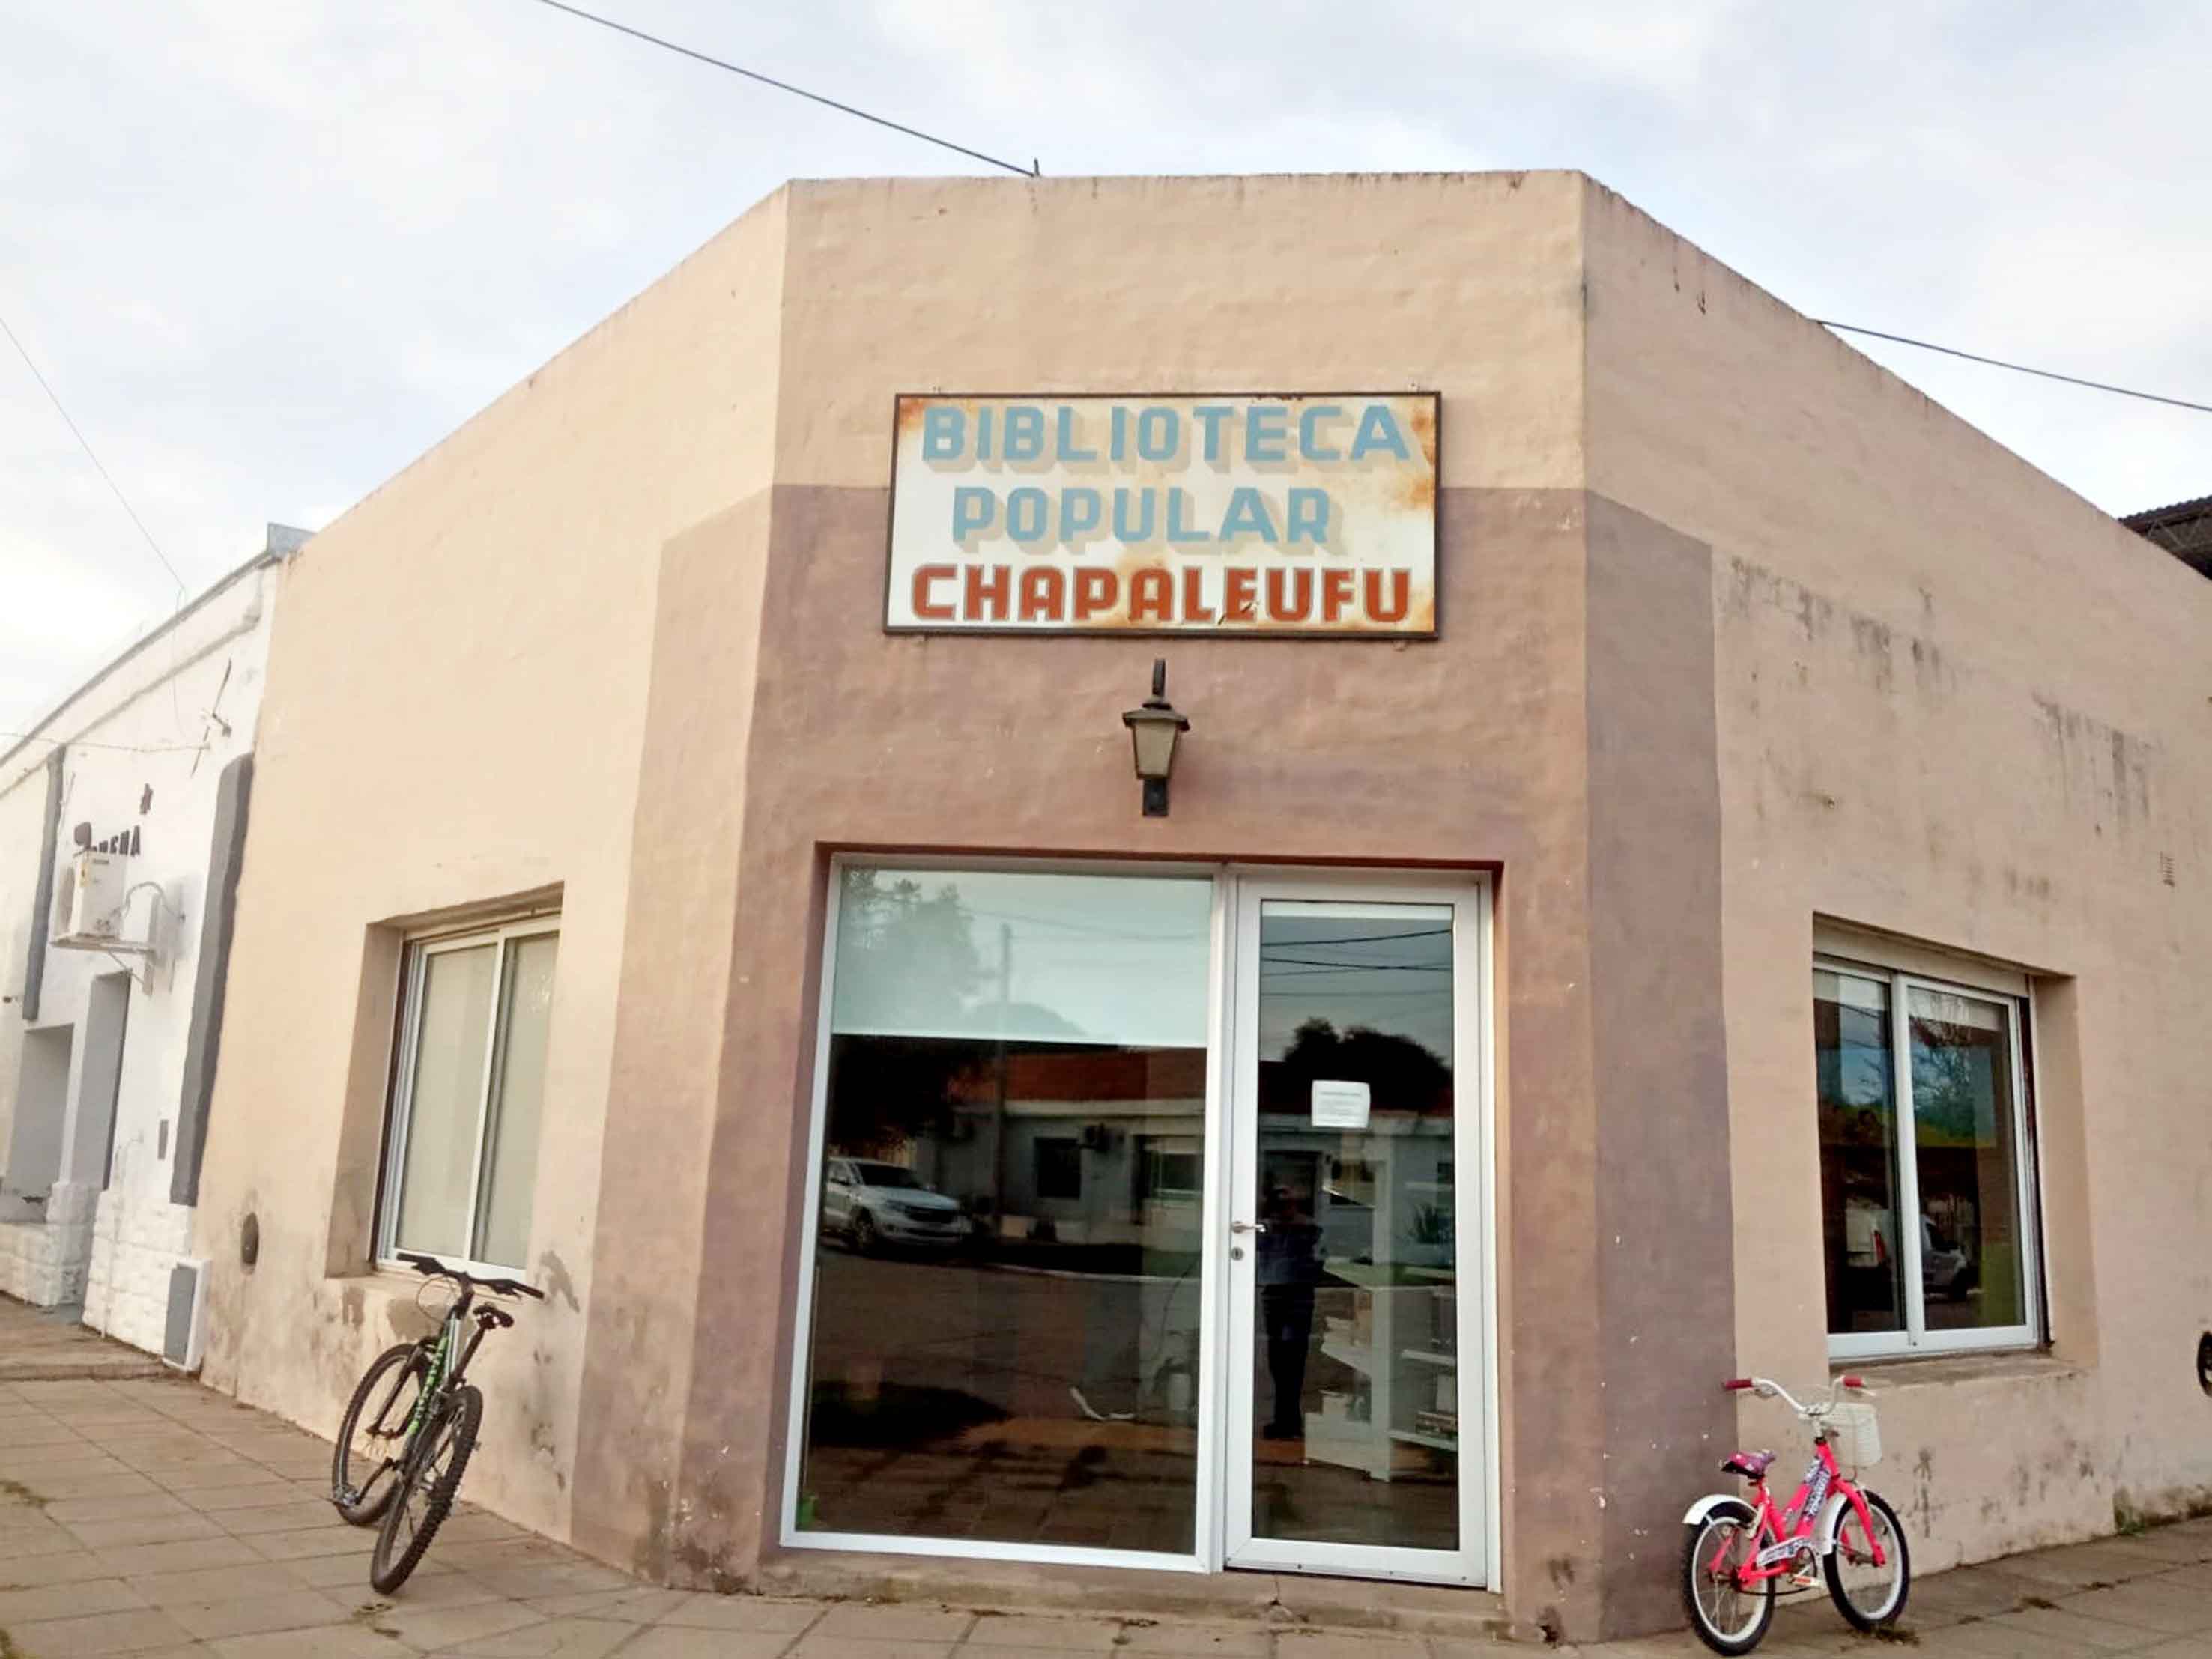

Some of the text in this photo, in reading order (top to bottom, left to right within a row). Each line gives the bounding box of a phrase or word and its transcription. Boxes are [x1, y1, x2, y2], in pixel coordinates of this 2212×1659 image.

[922, 405, 1411, 463] BIBLIOTECA
[952, 487, 1332, 545] POPULAR
[911, 564, 1412, 623] CHAPALEUFU
